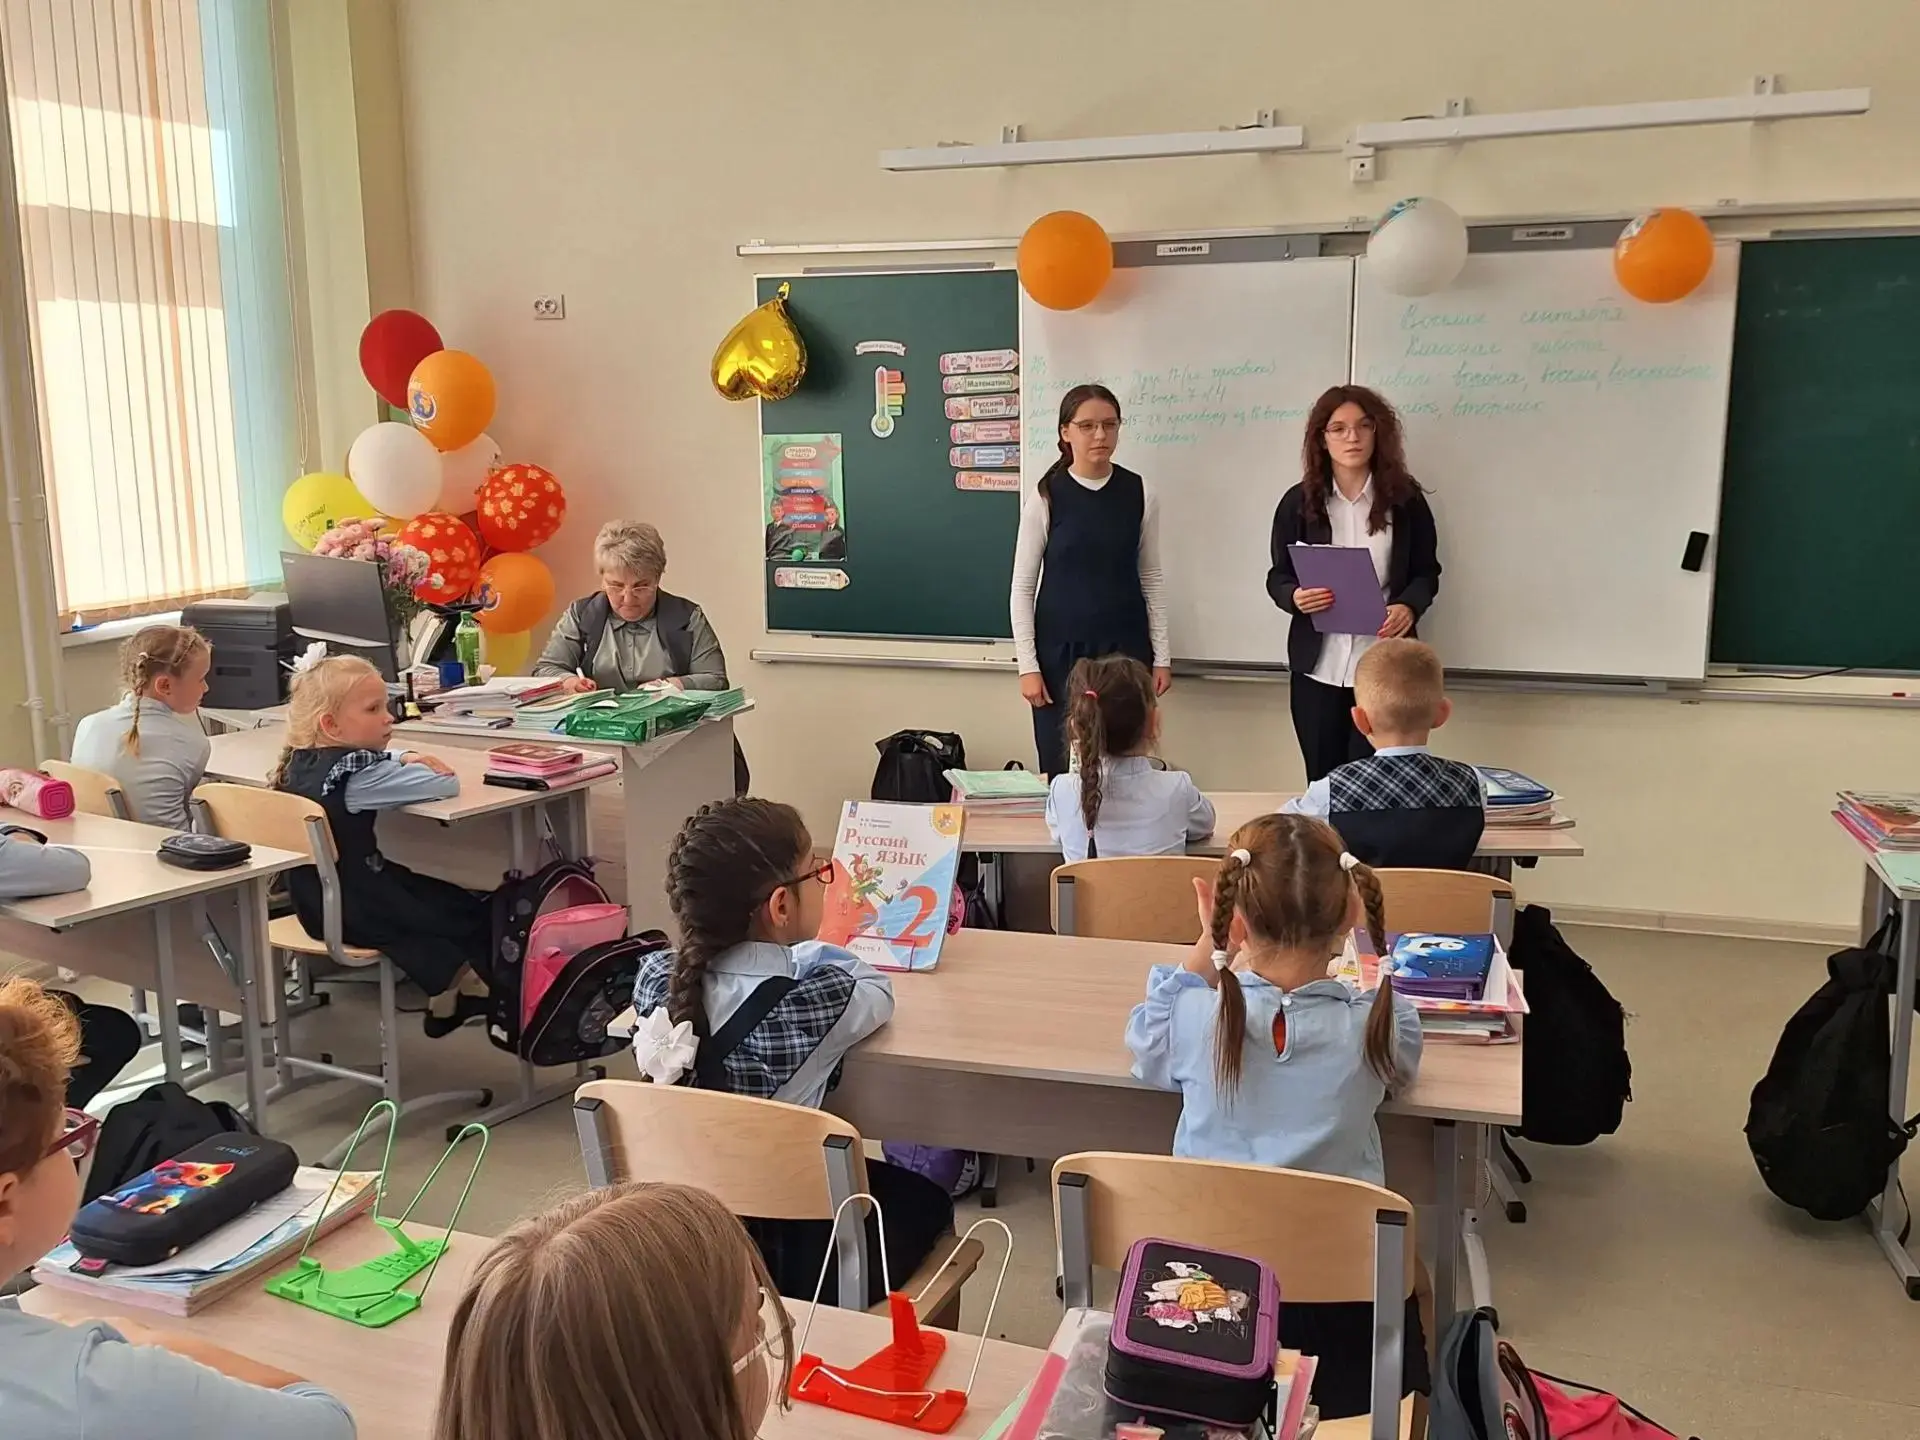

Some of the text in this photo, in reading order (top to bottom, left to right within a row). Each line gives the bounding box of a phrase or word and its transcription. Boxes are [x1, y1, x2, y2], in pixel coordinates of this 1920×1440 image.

[966, 379, 1011, 388] Математика
[972, 399, 1004, 410] Русский
[983, 476, 1018, 487] Музыка
[843, 827, 909, 849] Русский
[891, 885, 939, 948] 2
